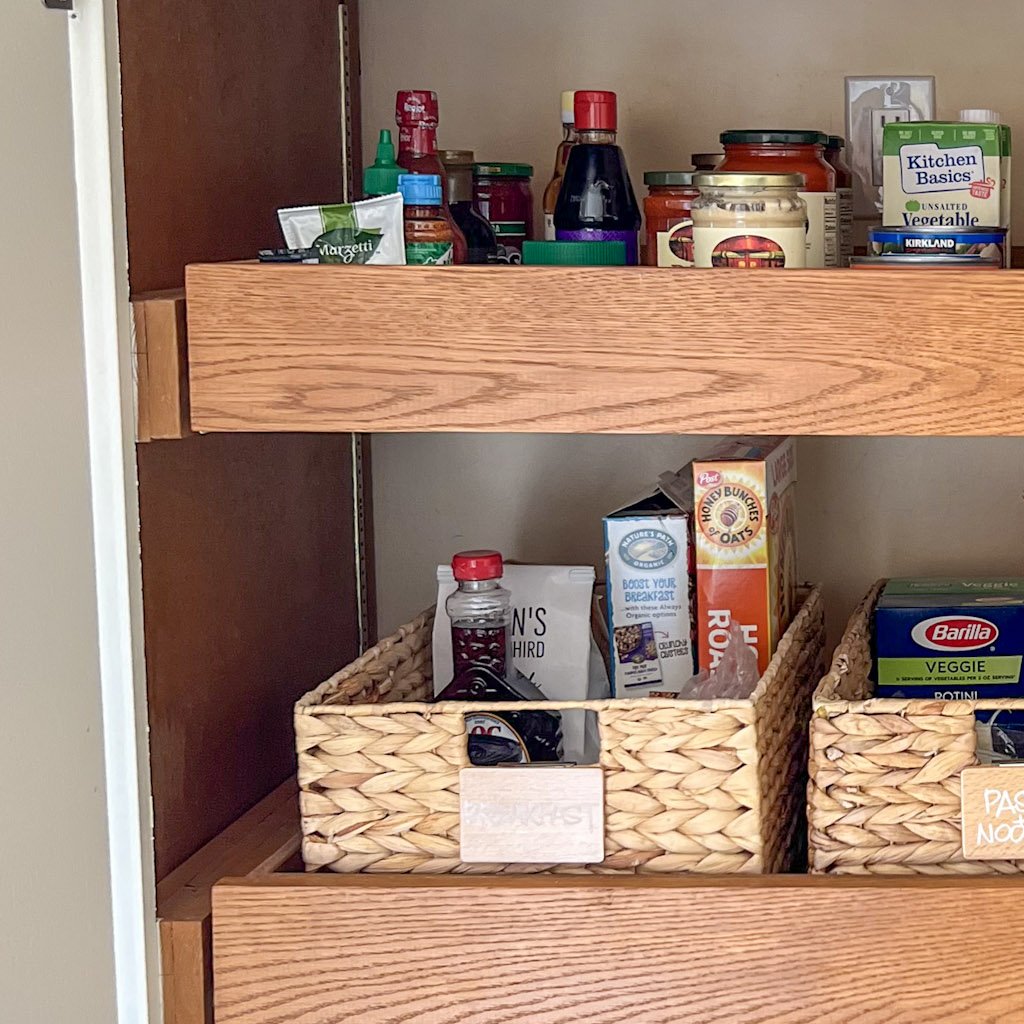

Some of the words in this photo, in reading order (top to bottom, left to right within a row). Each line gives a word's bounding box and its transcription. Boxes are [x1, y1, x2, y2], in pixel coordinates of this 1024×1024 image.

[907, 154, 977, 169] Kitchen
[916, 170, 971, 185] Basics
[922, 203, 968, 211] UNSALTED
[902, 212, 979, 226] Vegetable
[905, 239, 954, 247] KIRKLAND
[699, 473, 719, 484] Post
[701, 487, 721, 522] HONEY
[724, 486, 758, 521] BUNCHES
[621, 530, 655, 547] NATURE'S
[656, 532, 674, 547] PATH
[708, 526, 720, 536] of
[720, 526, 753, 543] OATS
[634, 560, 665, 568] ORGANIC
[652, 578, 677, 589] YOUR
[512, 607, 547, 636] N'S
[932, 624, 991, 640] Barilla
[513, 641, 545, 658] HIRD
[926, 661, 986, 673] VEGGIE
